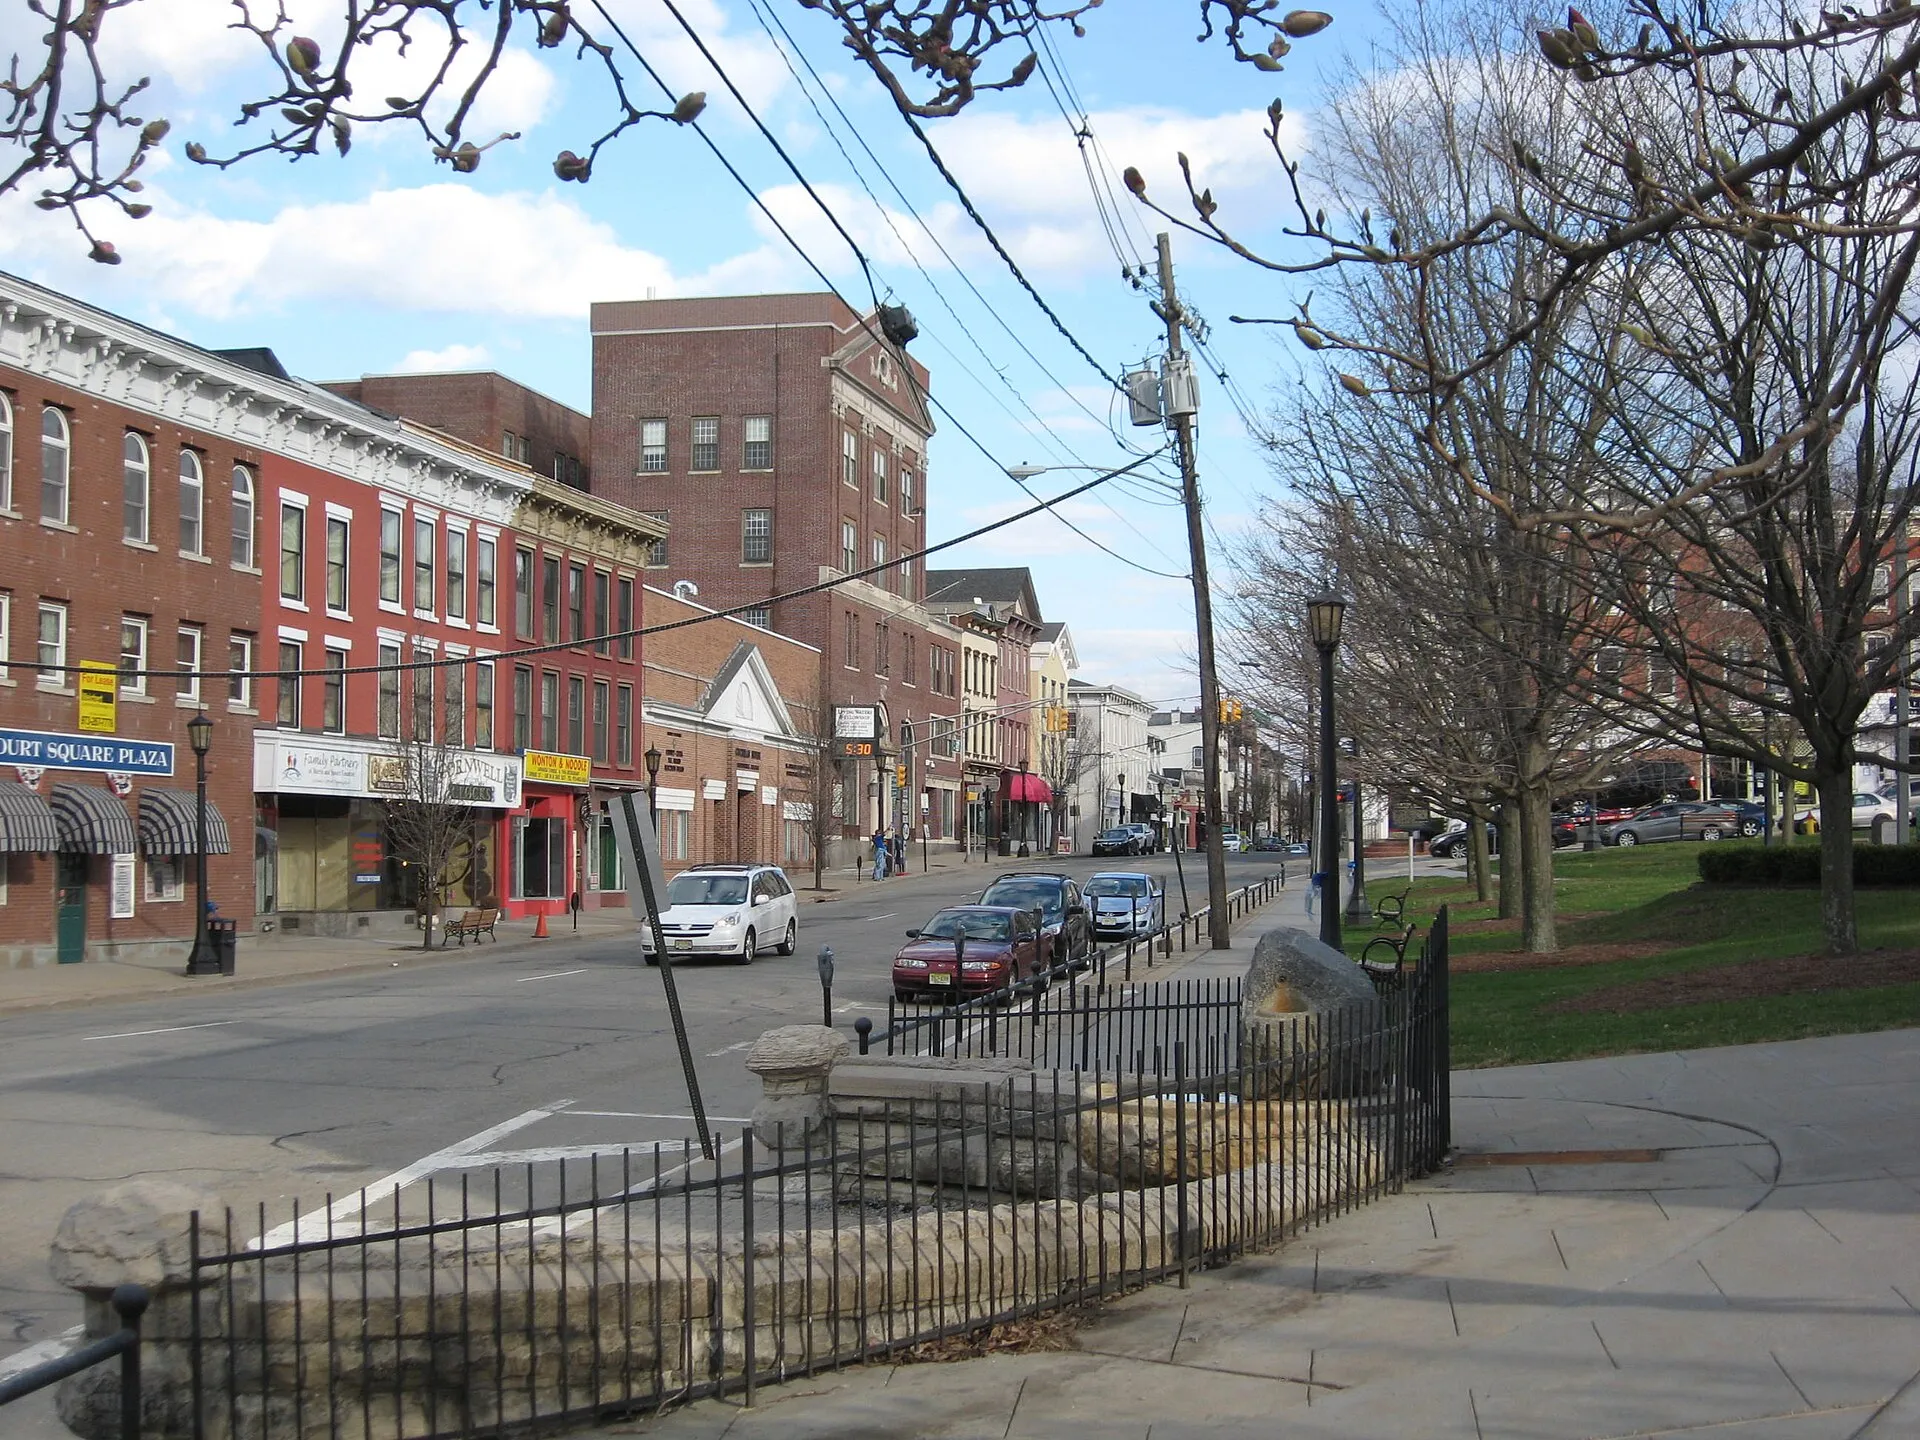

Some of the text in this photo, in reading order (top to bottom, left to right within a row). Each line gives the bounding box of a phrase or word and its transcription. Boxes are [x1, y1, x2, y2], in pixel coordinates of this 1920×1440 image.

[47, 742, 114, 763] SQUARE
[118, 748, 168, 767] PLAZA
[845, 743, 872, 755] 5:30
[304, 752, 328, 769] Family
[531, 754, 557, 768] WONTON
[559, 758, 563, 768] &
[565, 759, 588, 771] NOODLE
